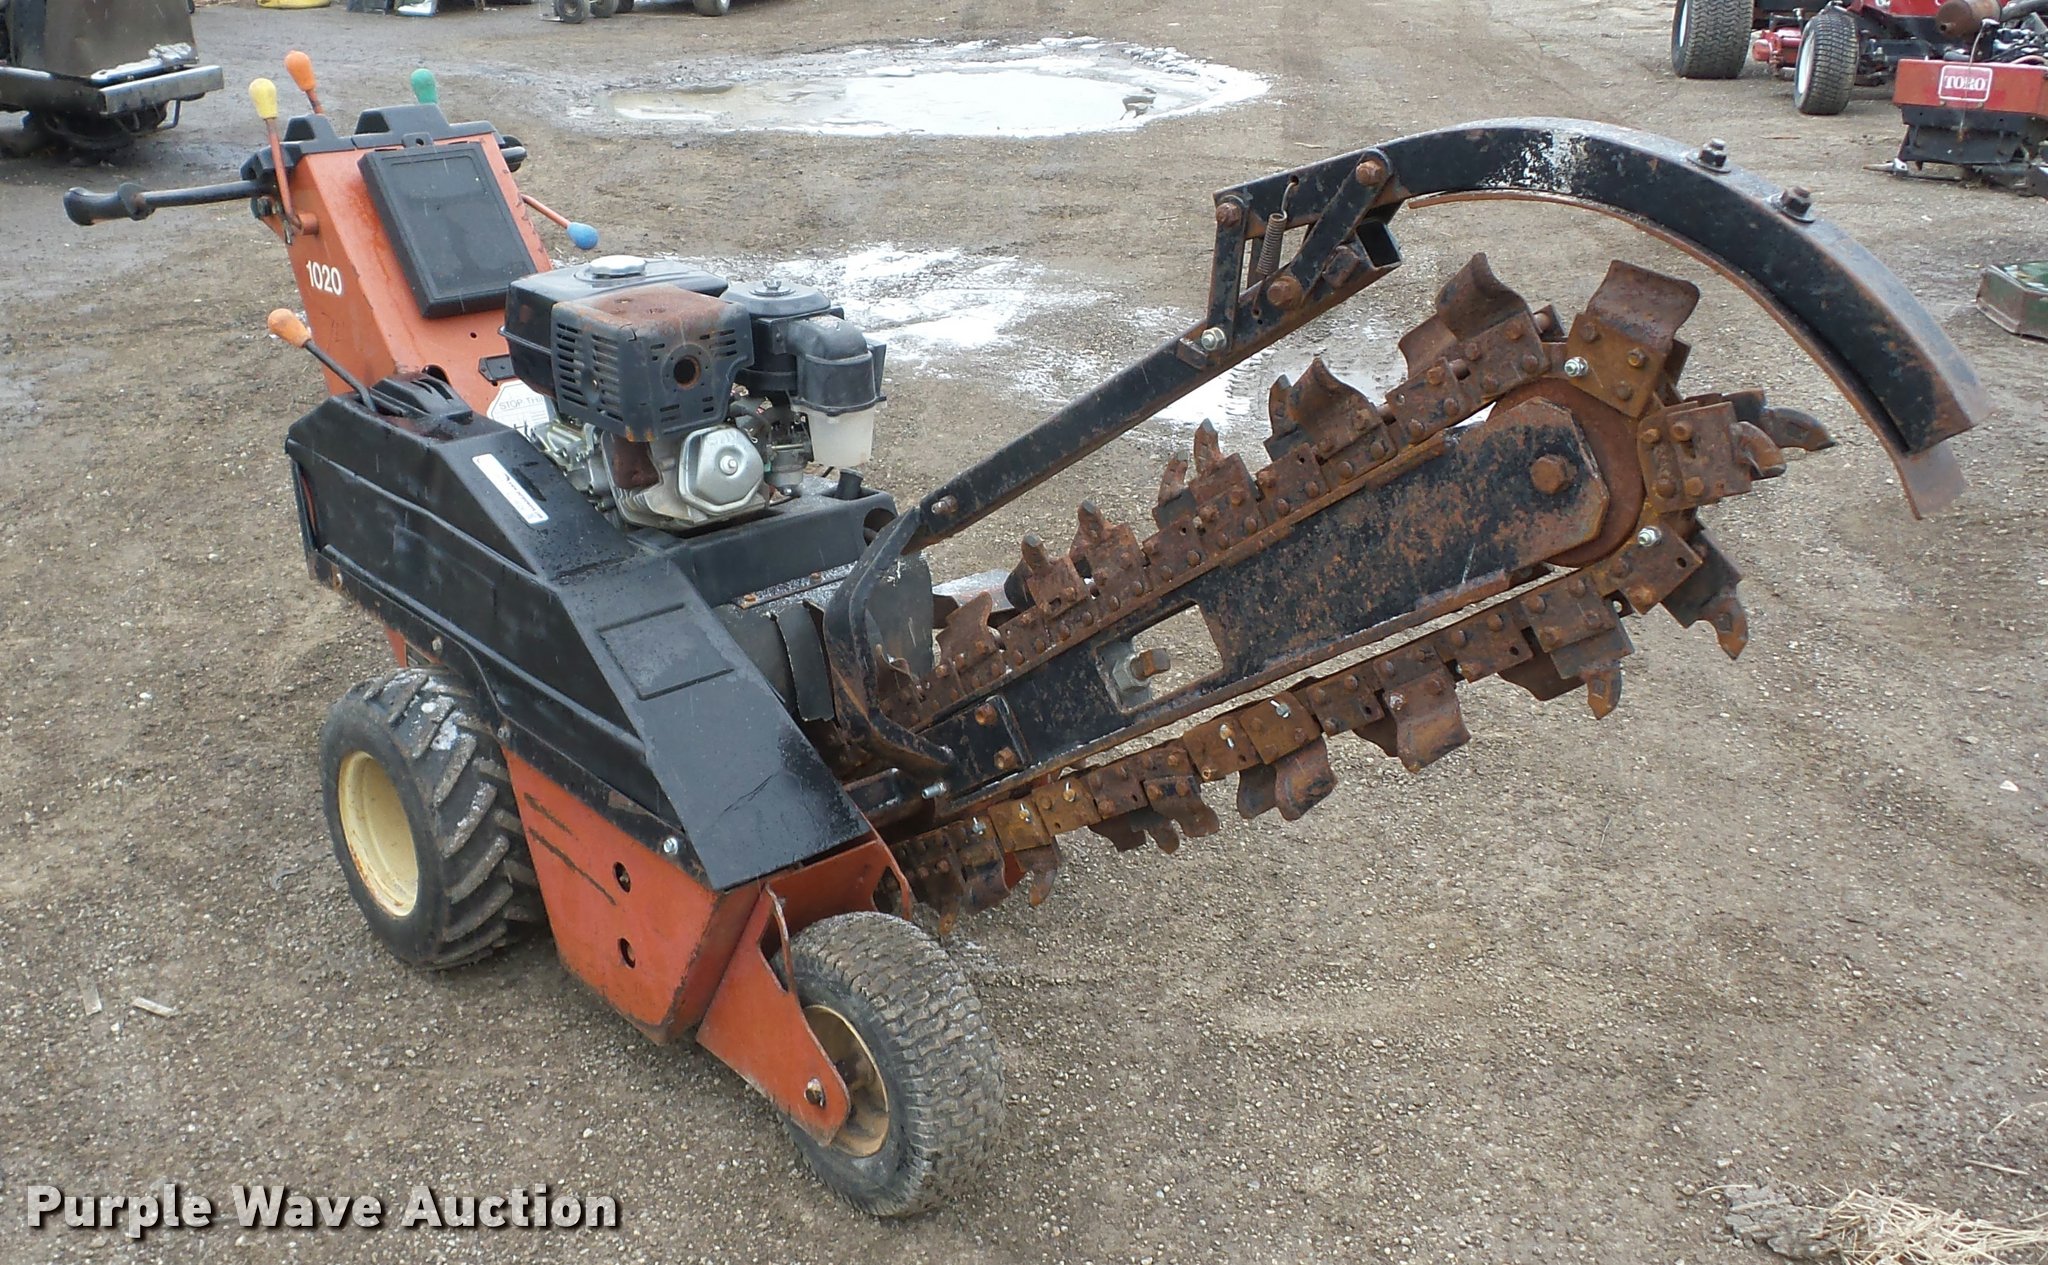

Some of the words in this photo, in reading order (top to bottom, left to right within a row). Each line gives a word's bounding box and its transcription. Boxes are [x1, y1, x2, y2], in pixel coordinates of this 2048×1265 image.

[1944, 75, 1986, 91] TORO
[306, 260, 342, 296] 1020
[499, 398, 523, 410] STOP
